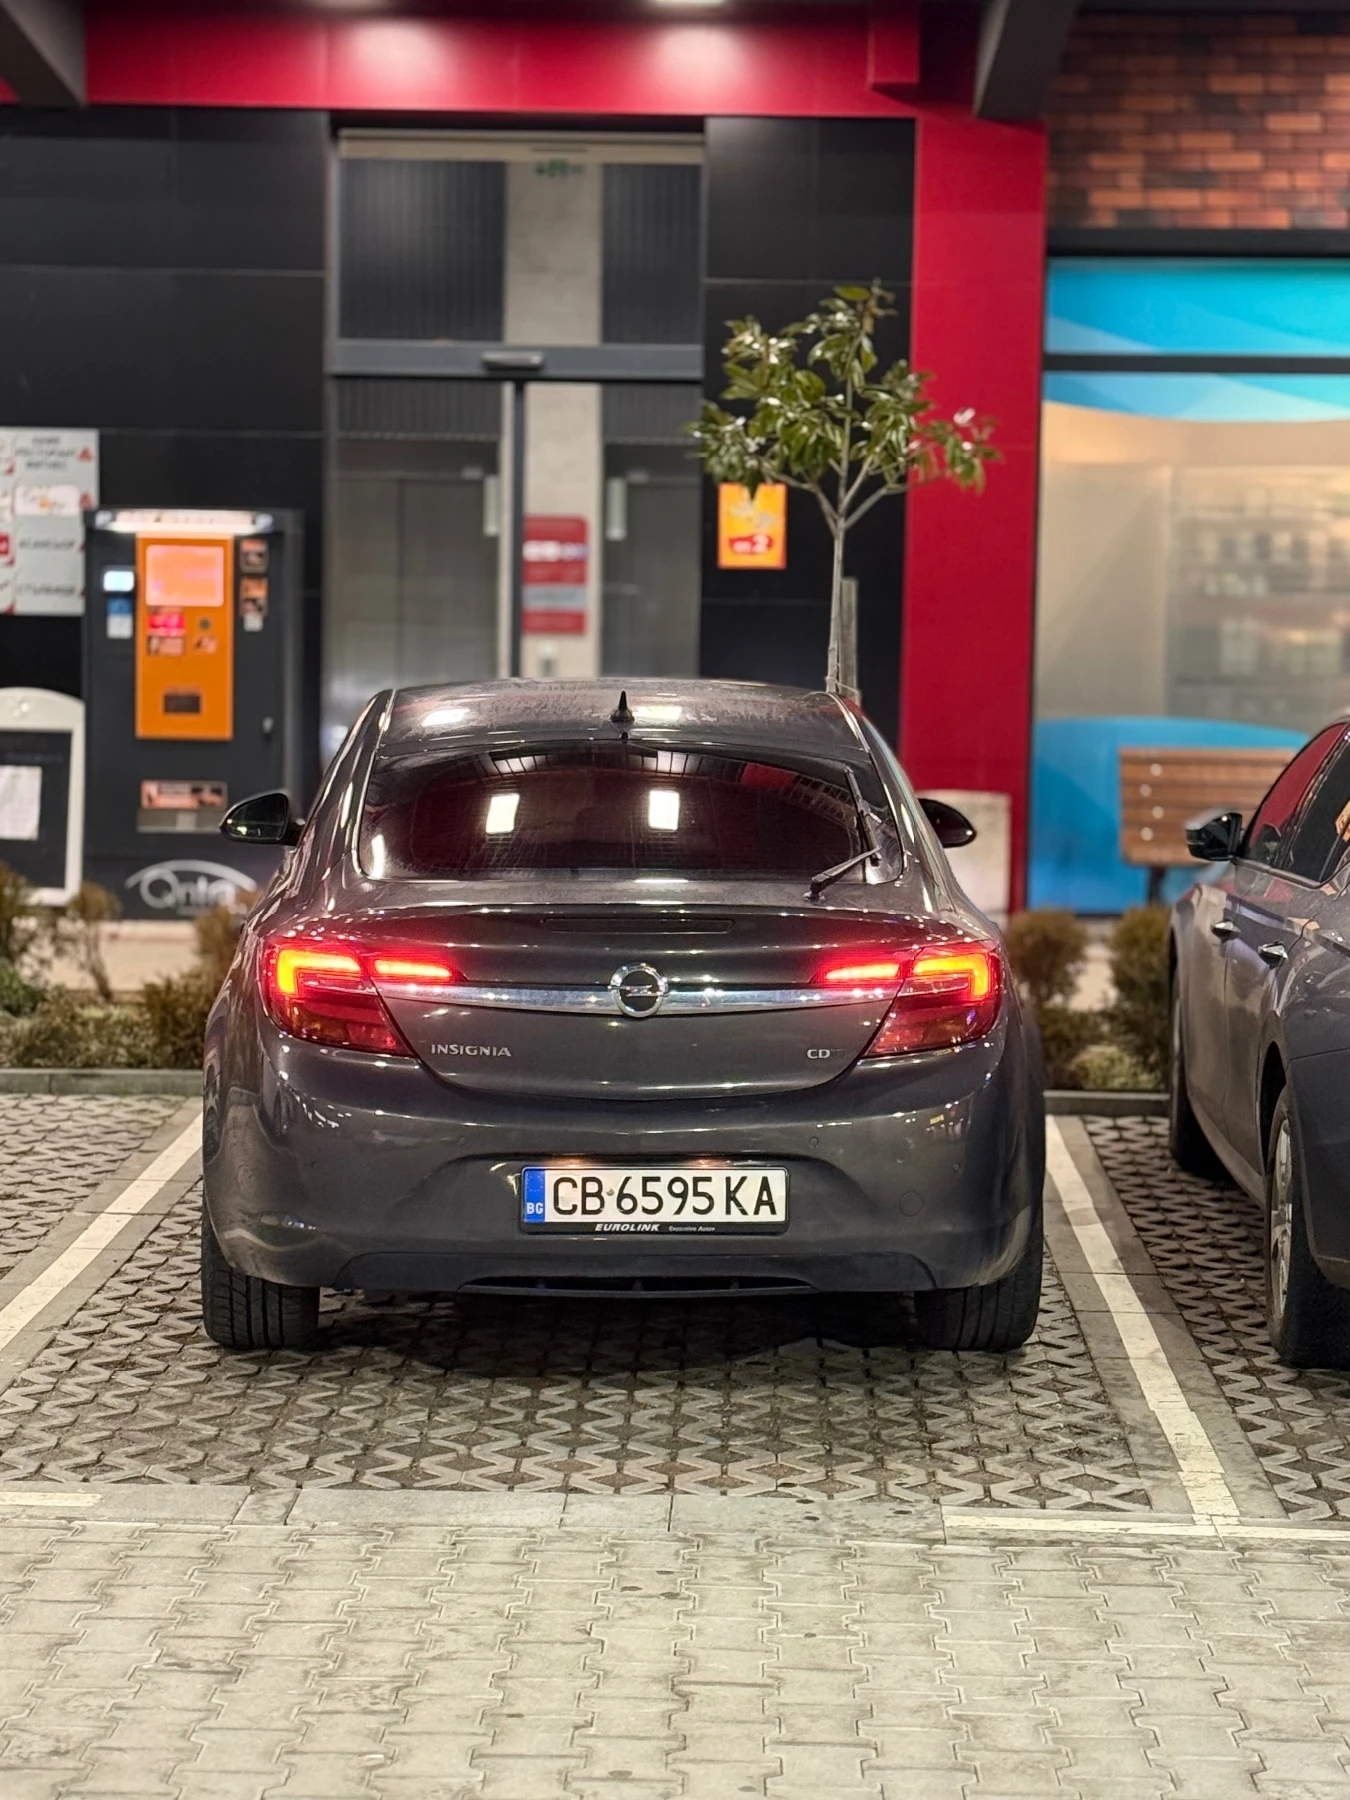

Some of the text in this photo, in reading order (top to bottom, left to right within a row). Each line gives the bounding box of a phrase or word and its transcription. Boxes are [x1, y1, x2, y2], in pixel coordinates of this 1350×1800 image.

[431, 1044, 512, 1057] INSIGNIA
[553, 1176, 777, 1215] CB 6595 KA
[526, 1202, 544, 1215] BG
[595, 1223, 660, 1232] EUROLINK
